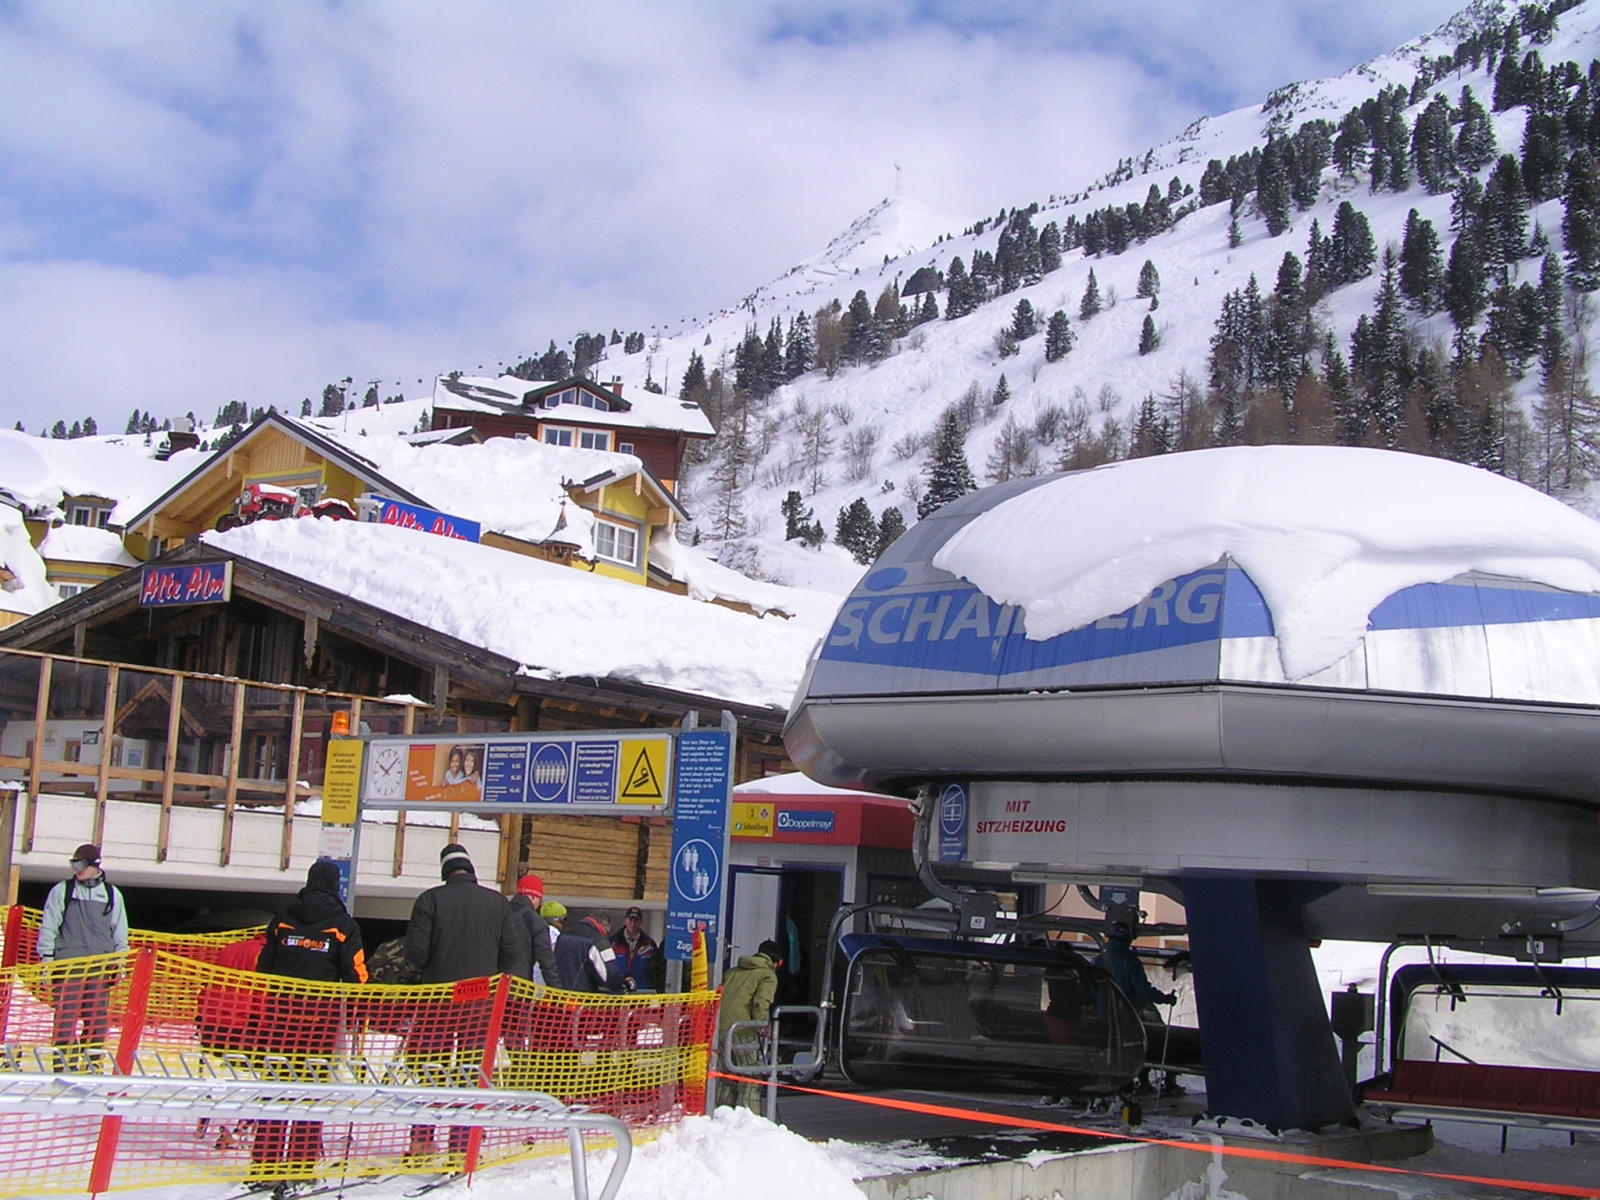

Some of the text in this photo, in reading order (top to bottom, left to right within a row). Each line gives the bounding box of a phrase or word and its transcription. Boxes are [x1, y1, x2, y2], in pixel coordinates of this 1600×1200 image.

[142, 567, 225, 604] Alte Alm
[1005, 800, 1031, 813] MIT
[788, 817, 833, 830] Doppelmayr
[976, 820, 1067, 834] SITZHEIZUNG
[677, 940, 694, 953] Zug
